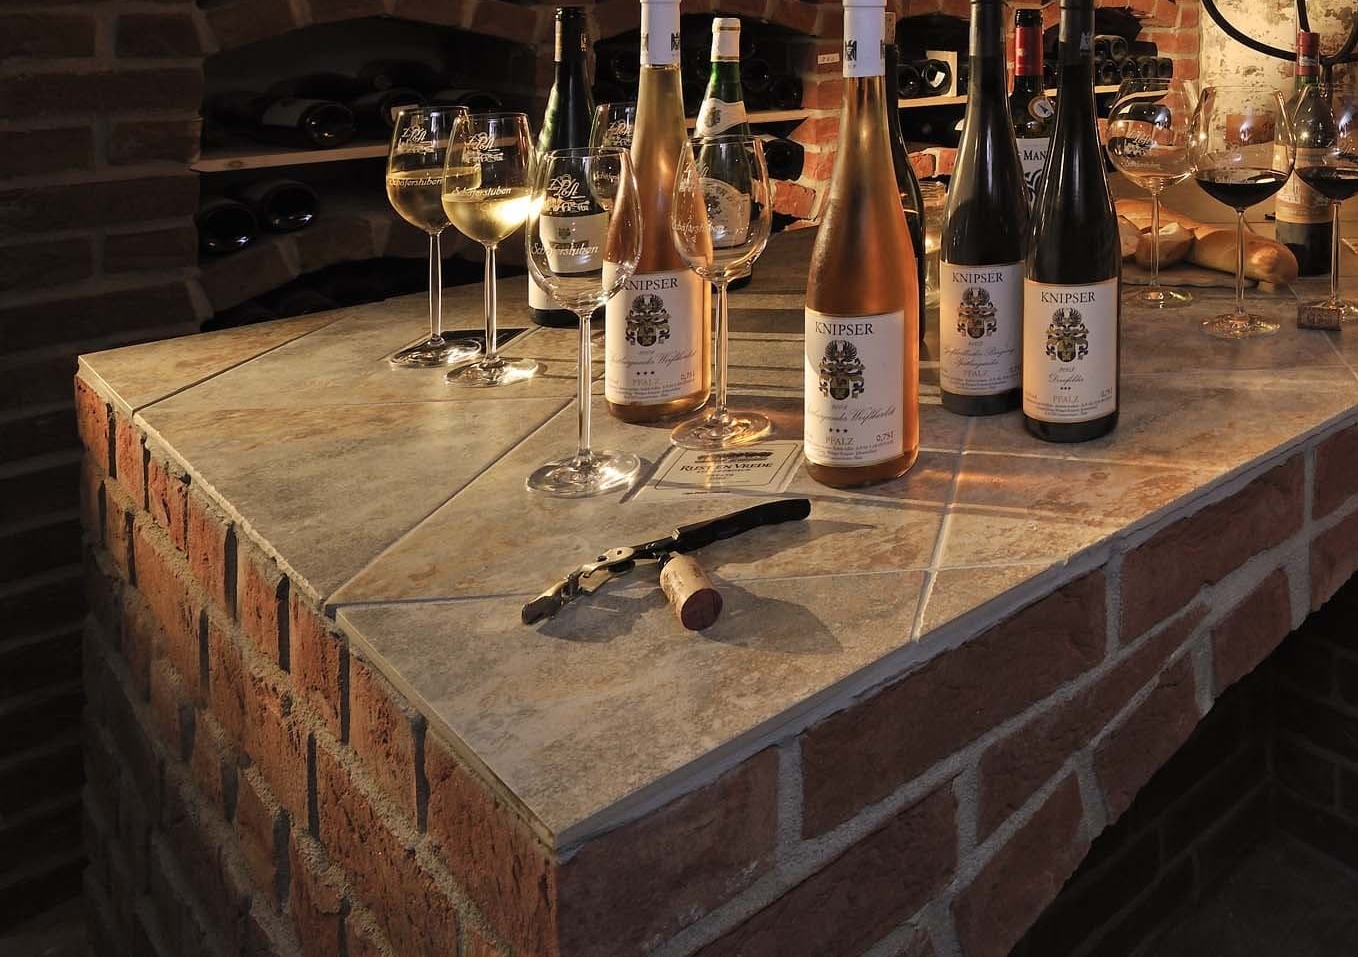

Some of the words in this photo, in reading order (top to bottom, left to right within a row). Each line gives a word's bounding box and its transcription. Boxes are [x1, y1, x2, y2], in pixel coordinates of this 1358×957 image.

[952, 272, 1004, 284] KNIPSER
[1041, 291, 1096, 304] KNIPSER
[815, 321, 874, 336] KNIPSER
